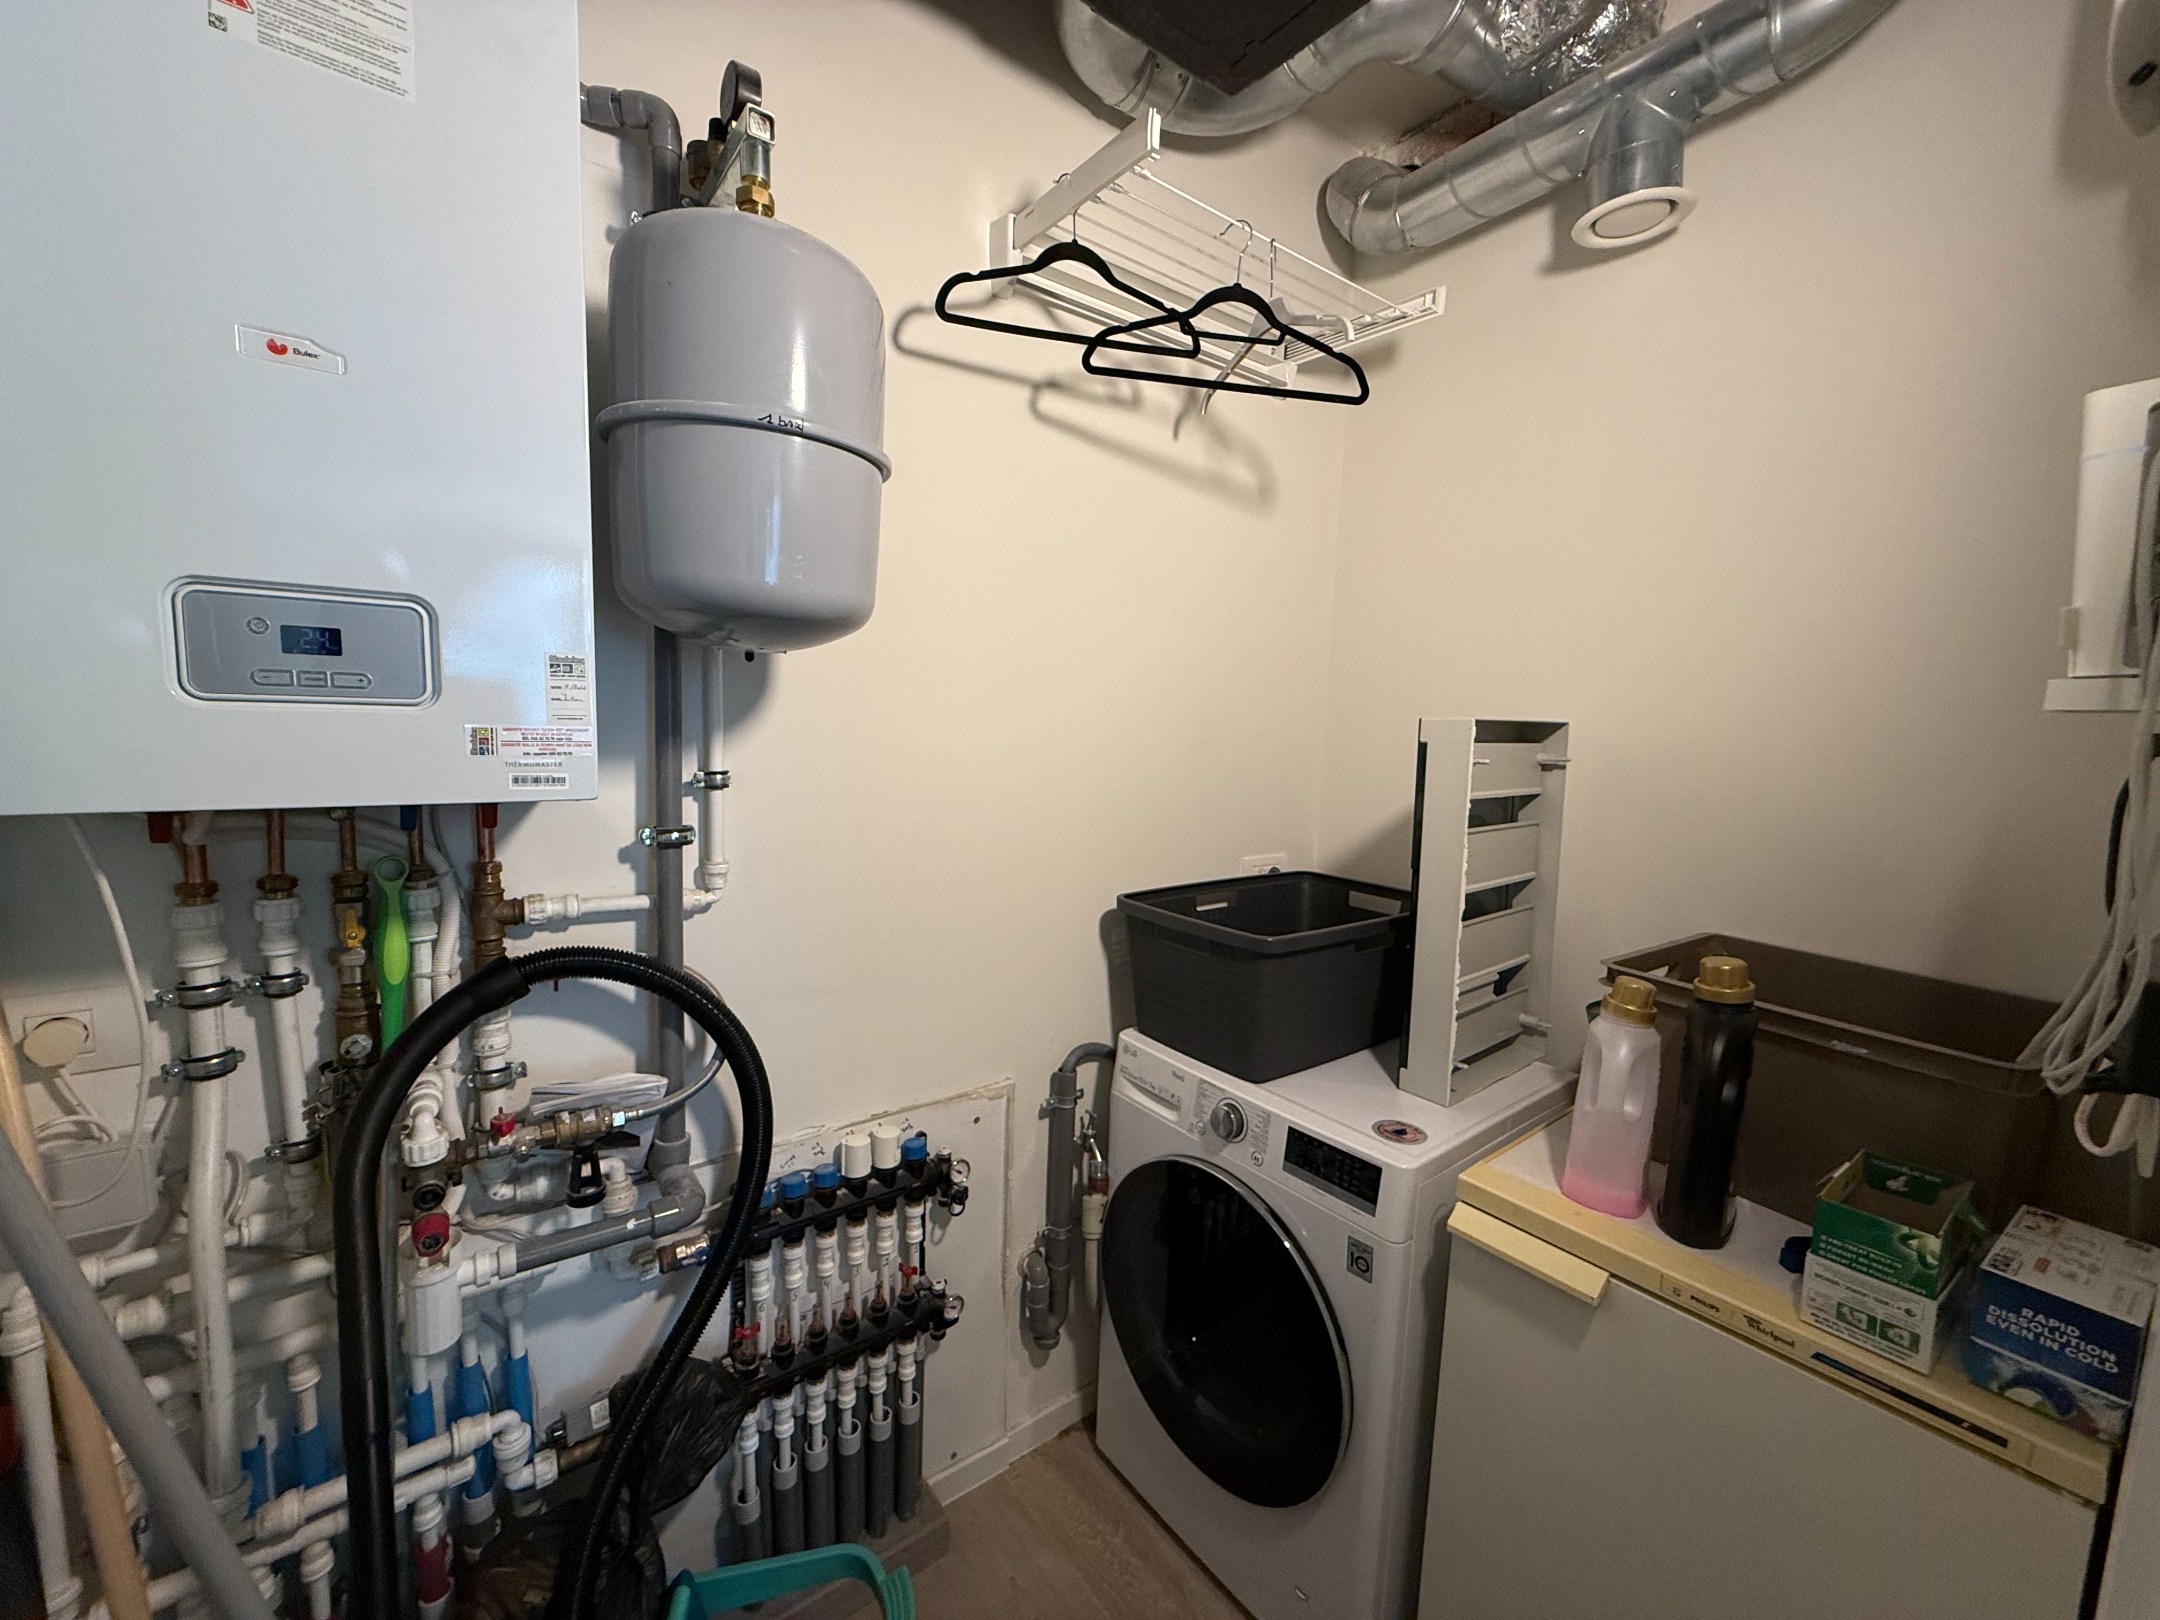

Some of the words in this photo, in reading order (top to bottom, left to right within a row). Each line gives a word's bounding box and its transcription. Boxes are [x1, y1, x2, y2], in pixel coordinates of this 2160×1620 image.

[292, 347, 319, 359] Bulex
[1350, 1251, 1370, 1273] 10
[1690, 1294, 1720, 1313] PHILIPS
[1746, 1319, 1795, 1348] Whirlpool
[1987, 1304, 2118, 1363] DISSOLUTION
[2020, 1307, 2080, 1337] RAPID
[1985, 1314, 2034, 1341] EVEN
[2039, 1335, 2060, 1351] IN
[2064, 1347, 2119, 1374] COLD
